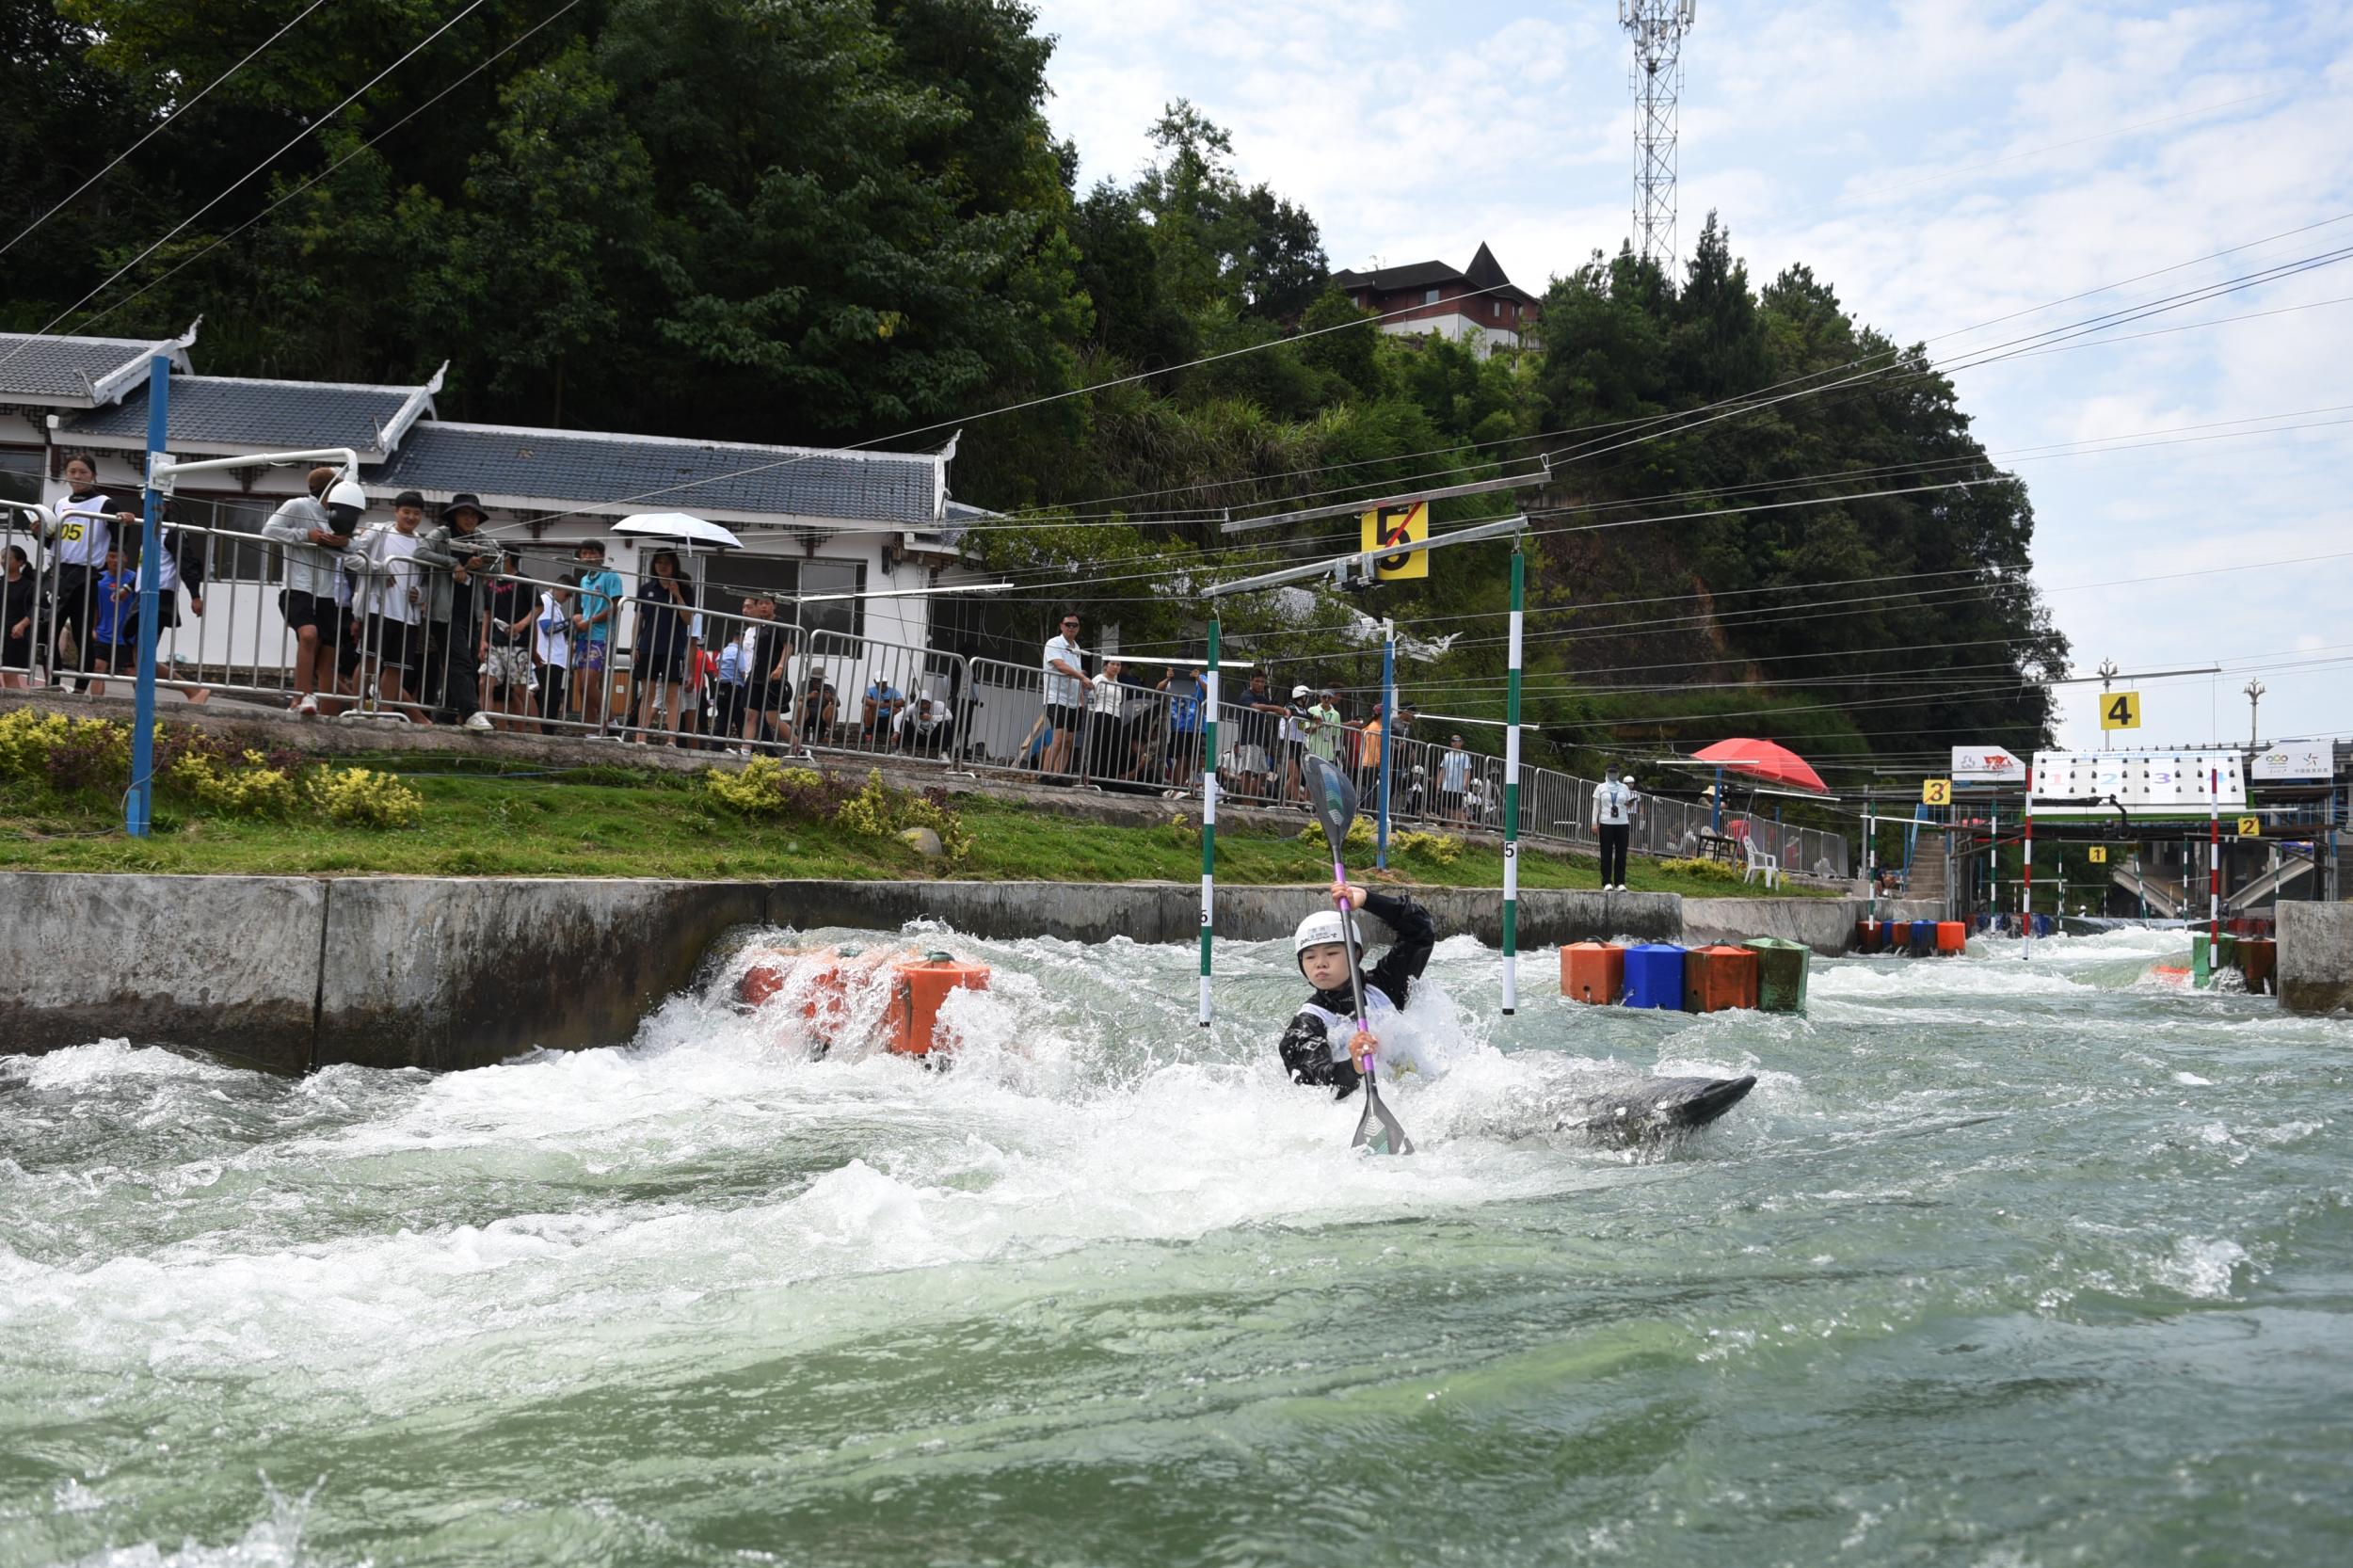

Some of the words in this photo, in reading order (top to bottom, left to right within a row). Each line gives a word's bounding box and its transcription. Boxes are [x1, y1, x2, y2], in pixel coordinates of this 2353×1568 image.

[1377, 506, 1412, 571] 5
[2108, 696, 2133, 725] 4
[2048, 774, 2065, 785] 1
[2100, 773, 2119, 784] 2
[2153, 773, 2171, 784] 3
[1930, 782, 1944, 802] 3
[2243, 820, 2255, 834] 2
[1505, 842, 1514, 857] 5
[2094, 849, 2100, 860] 1
[1199, 909, 1209, 923] 5
